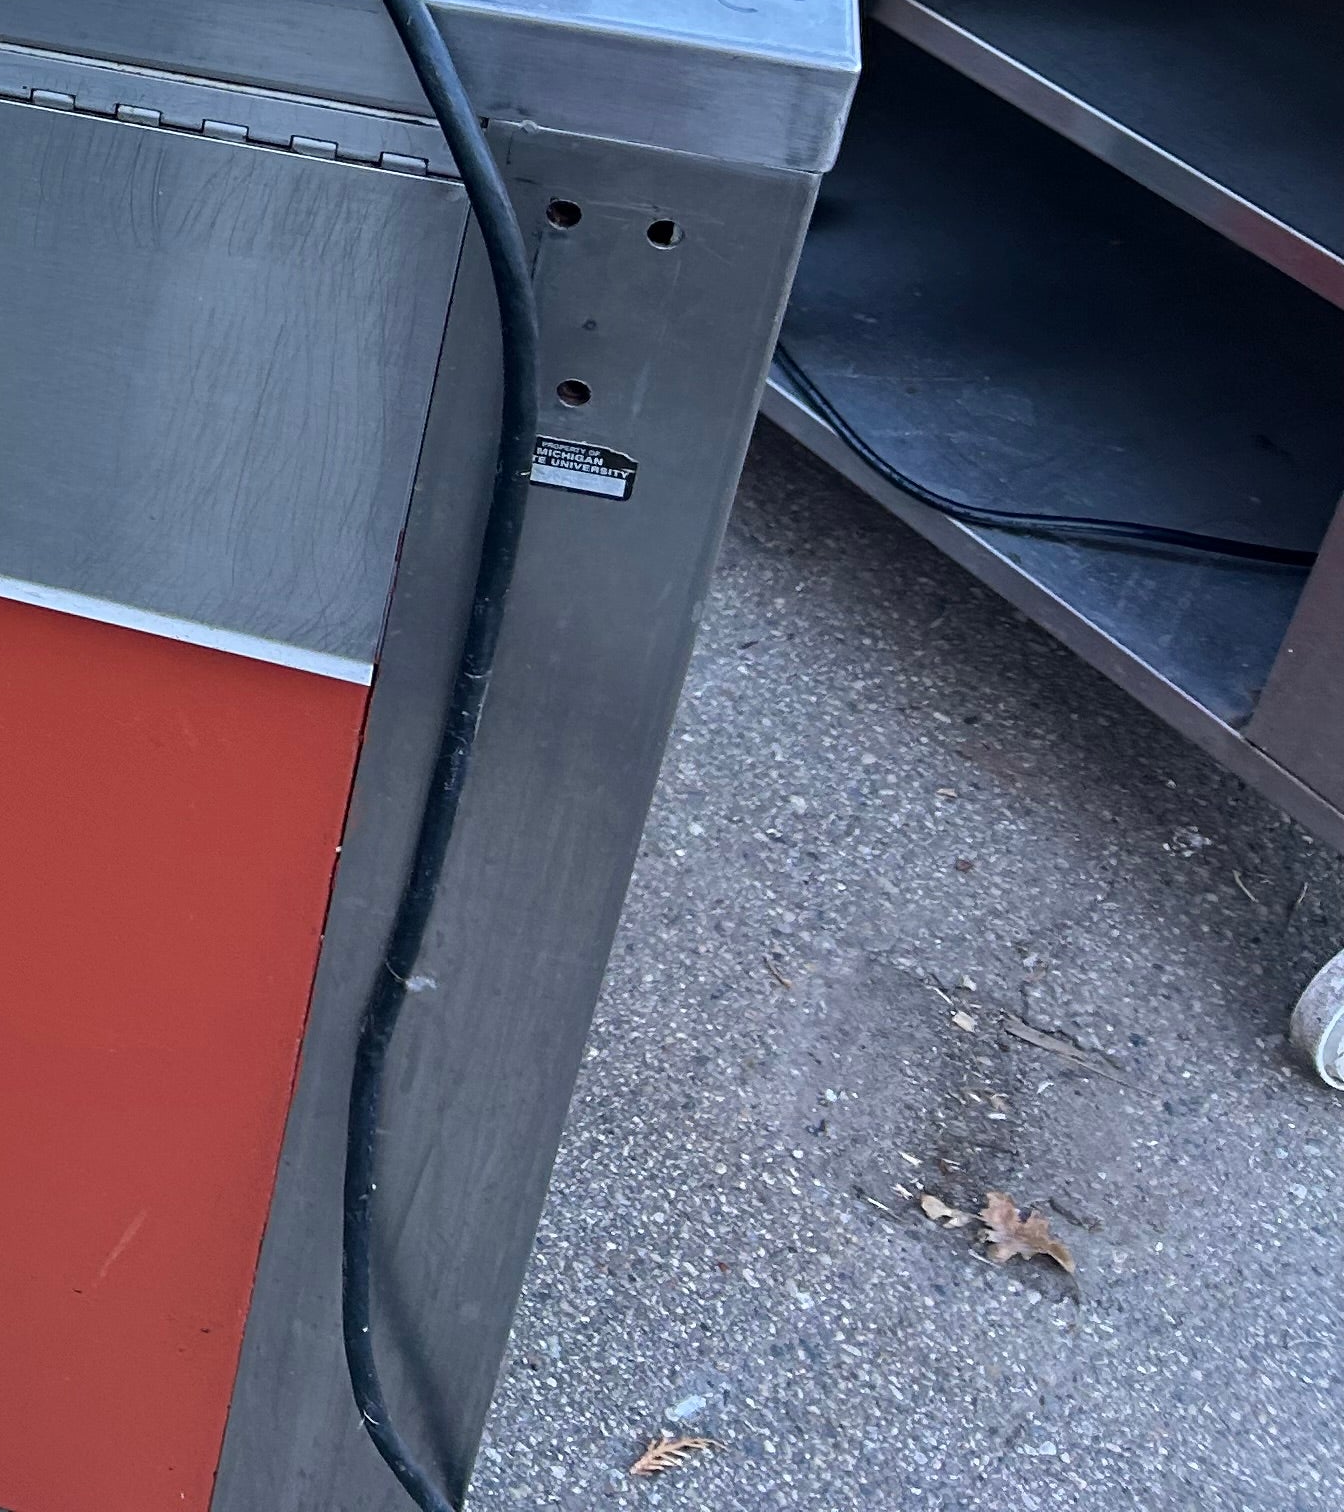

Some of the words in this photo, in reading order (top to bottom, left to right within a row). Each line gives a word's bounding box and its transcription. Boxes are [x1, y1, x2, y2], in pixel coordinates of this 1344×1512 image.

[536, 447, 604, 467] MICHIGAN
[541, 440, 587, 455] PROPERTY
[588, 449, 601, 458] OF
[550, 458, 630, 479] UNIVERSITY
